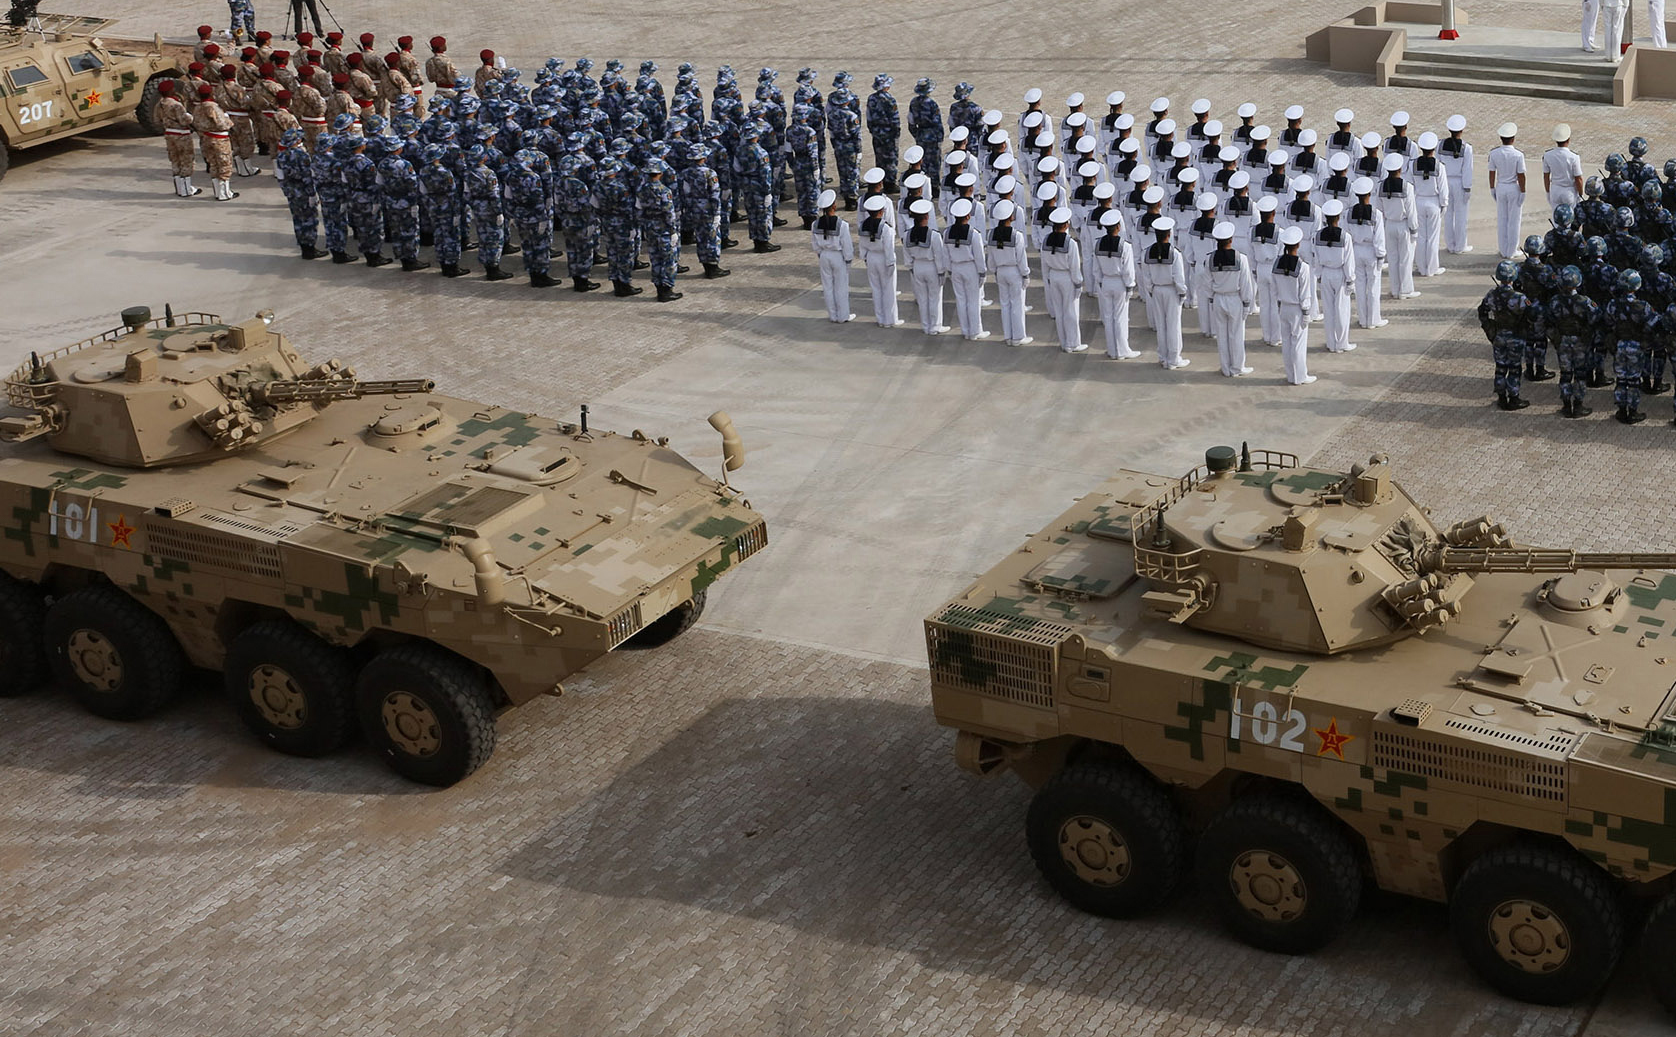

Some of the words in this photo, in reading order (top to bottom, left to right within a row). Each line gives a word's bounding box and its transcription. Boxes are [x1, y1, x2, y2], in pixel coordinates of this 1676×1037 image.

[19, 99, 53, 125] 207
[49, 499, 98, 543] 101
[1230, 698, 1307, 753] 102
